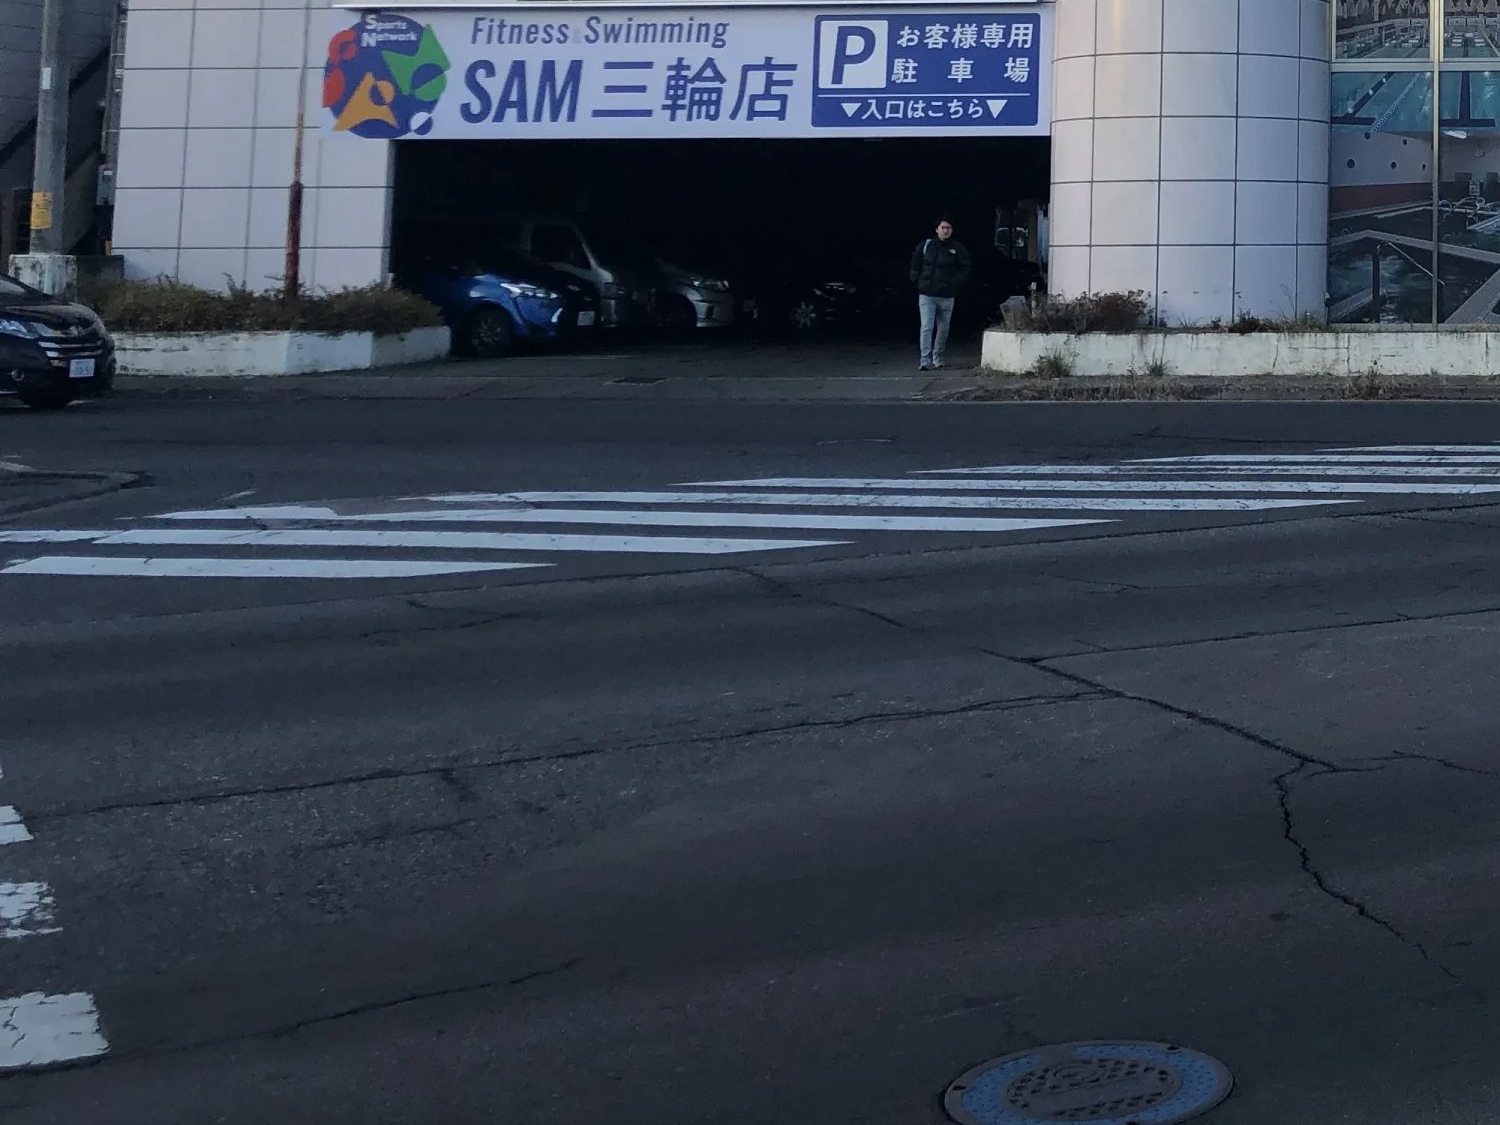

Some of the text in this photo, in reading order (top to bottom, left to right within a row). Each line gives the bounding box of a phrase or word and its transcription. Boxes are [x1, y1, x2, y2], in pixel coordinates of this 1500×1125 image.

[361, 32, 417, 47] Network
[471, 16, 569, 45] Fitness
[584, 15, 730, 49] Swimming
[896, 23, 1034, 49] お客様専用
[831, 25, 876, 85] P
[891, 58, 1031, 83] 駐車場
[861, 99, 984, 120] 入口はこちら
